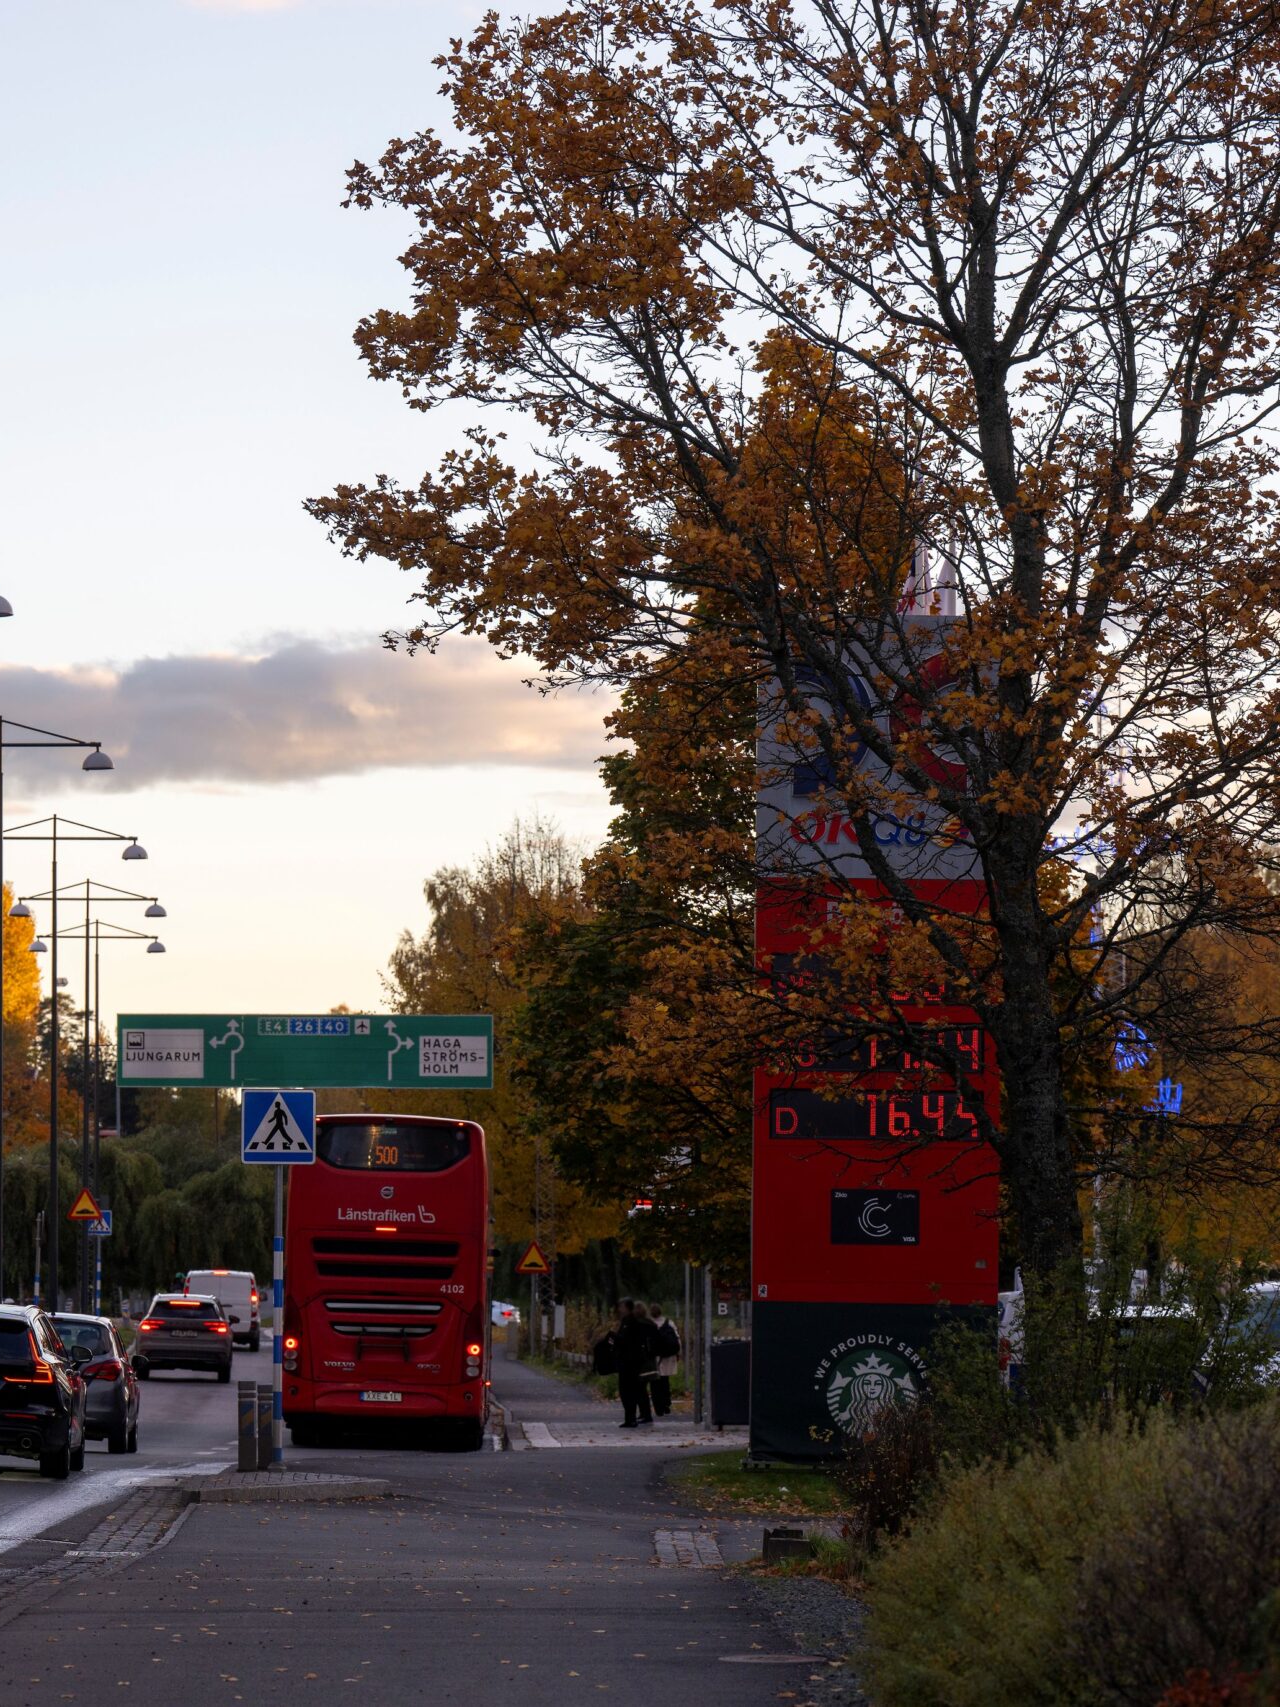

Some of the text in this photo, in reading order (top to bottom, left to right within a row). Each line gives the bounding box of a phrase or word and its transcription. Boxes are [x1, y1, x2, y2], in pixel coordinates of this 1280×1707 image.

[265, 1021, 344, 1031] E4 26 40
[423, 1038, 461, 1048] HAGA
[126, 1052, 200, 1061] LJUNGARUM
[423, 1049, 485, 1062] STRÖMS-
[423, 1064, 459, 1074] HOLM
[775, 1107, 799, 1135] D
[375, 1146, 399, 1165] 500
[337, 1207, 416, 1222] Länstrafiken
[440, 1284, 464, 1294] 4102
[813, 1333, 929, 1380] WE PROUDLY SERVE
